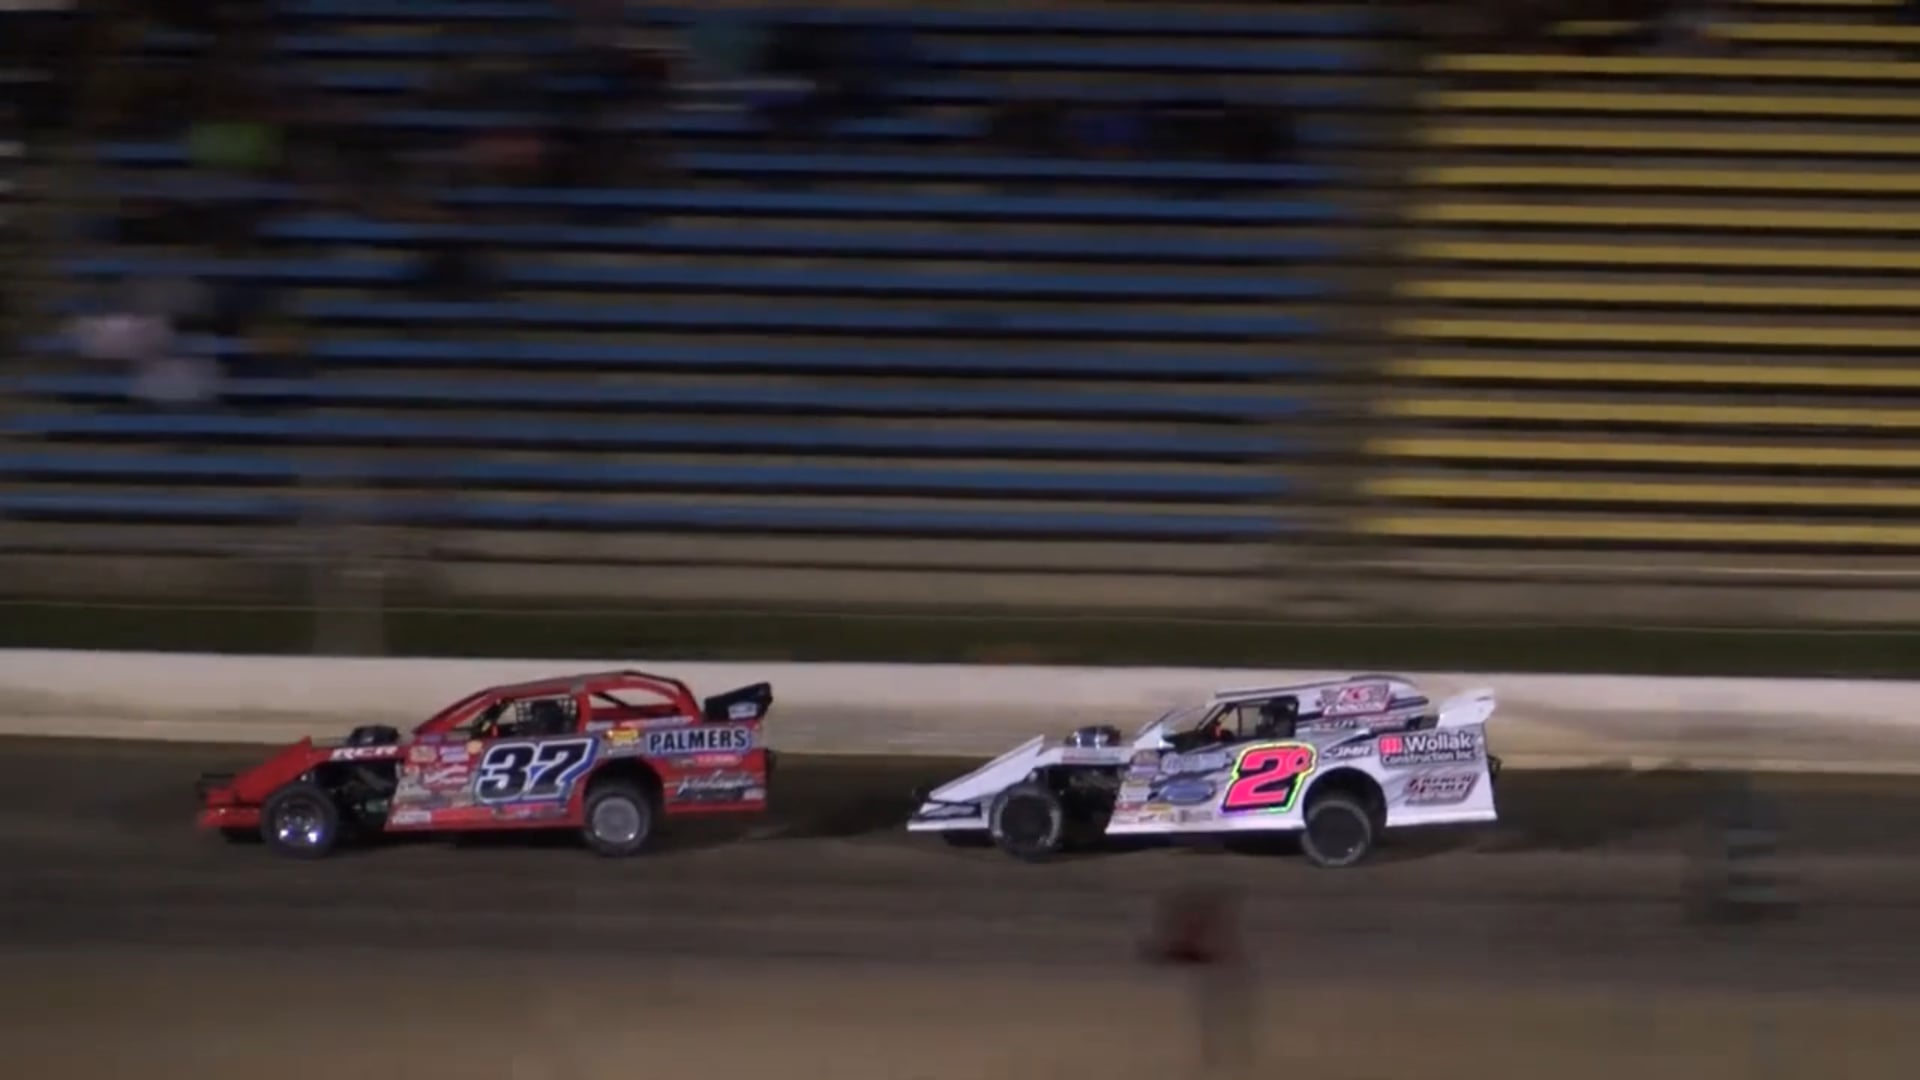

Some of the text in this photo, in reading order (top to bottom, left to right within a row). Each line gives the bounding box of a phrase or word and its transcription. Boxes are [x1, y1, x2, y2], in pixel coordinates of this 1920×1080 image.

[650, 729, 746, 751] PALMERS
[1405, 732, 1471, 751] Wollak
[1382, 752, 1454, 766] Construction
[475, 738, 593, 803] 37
